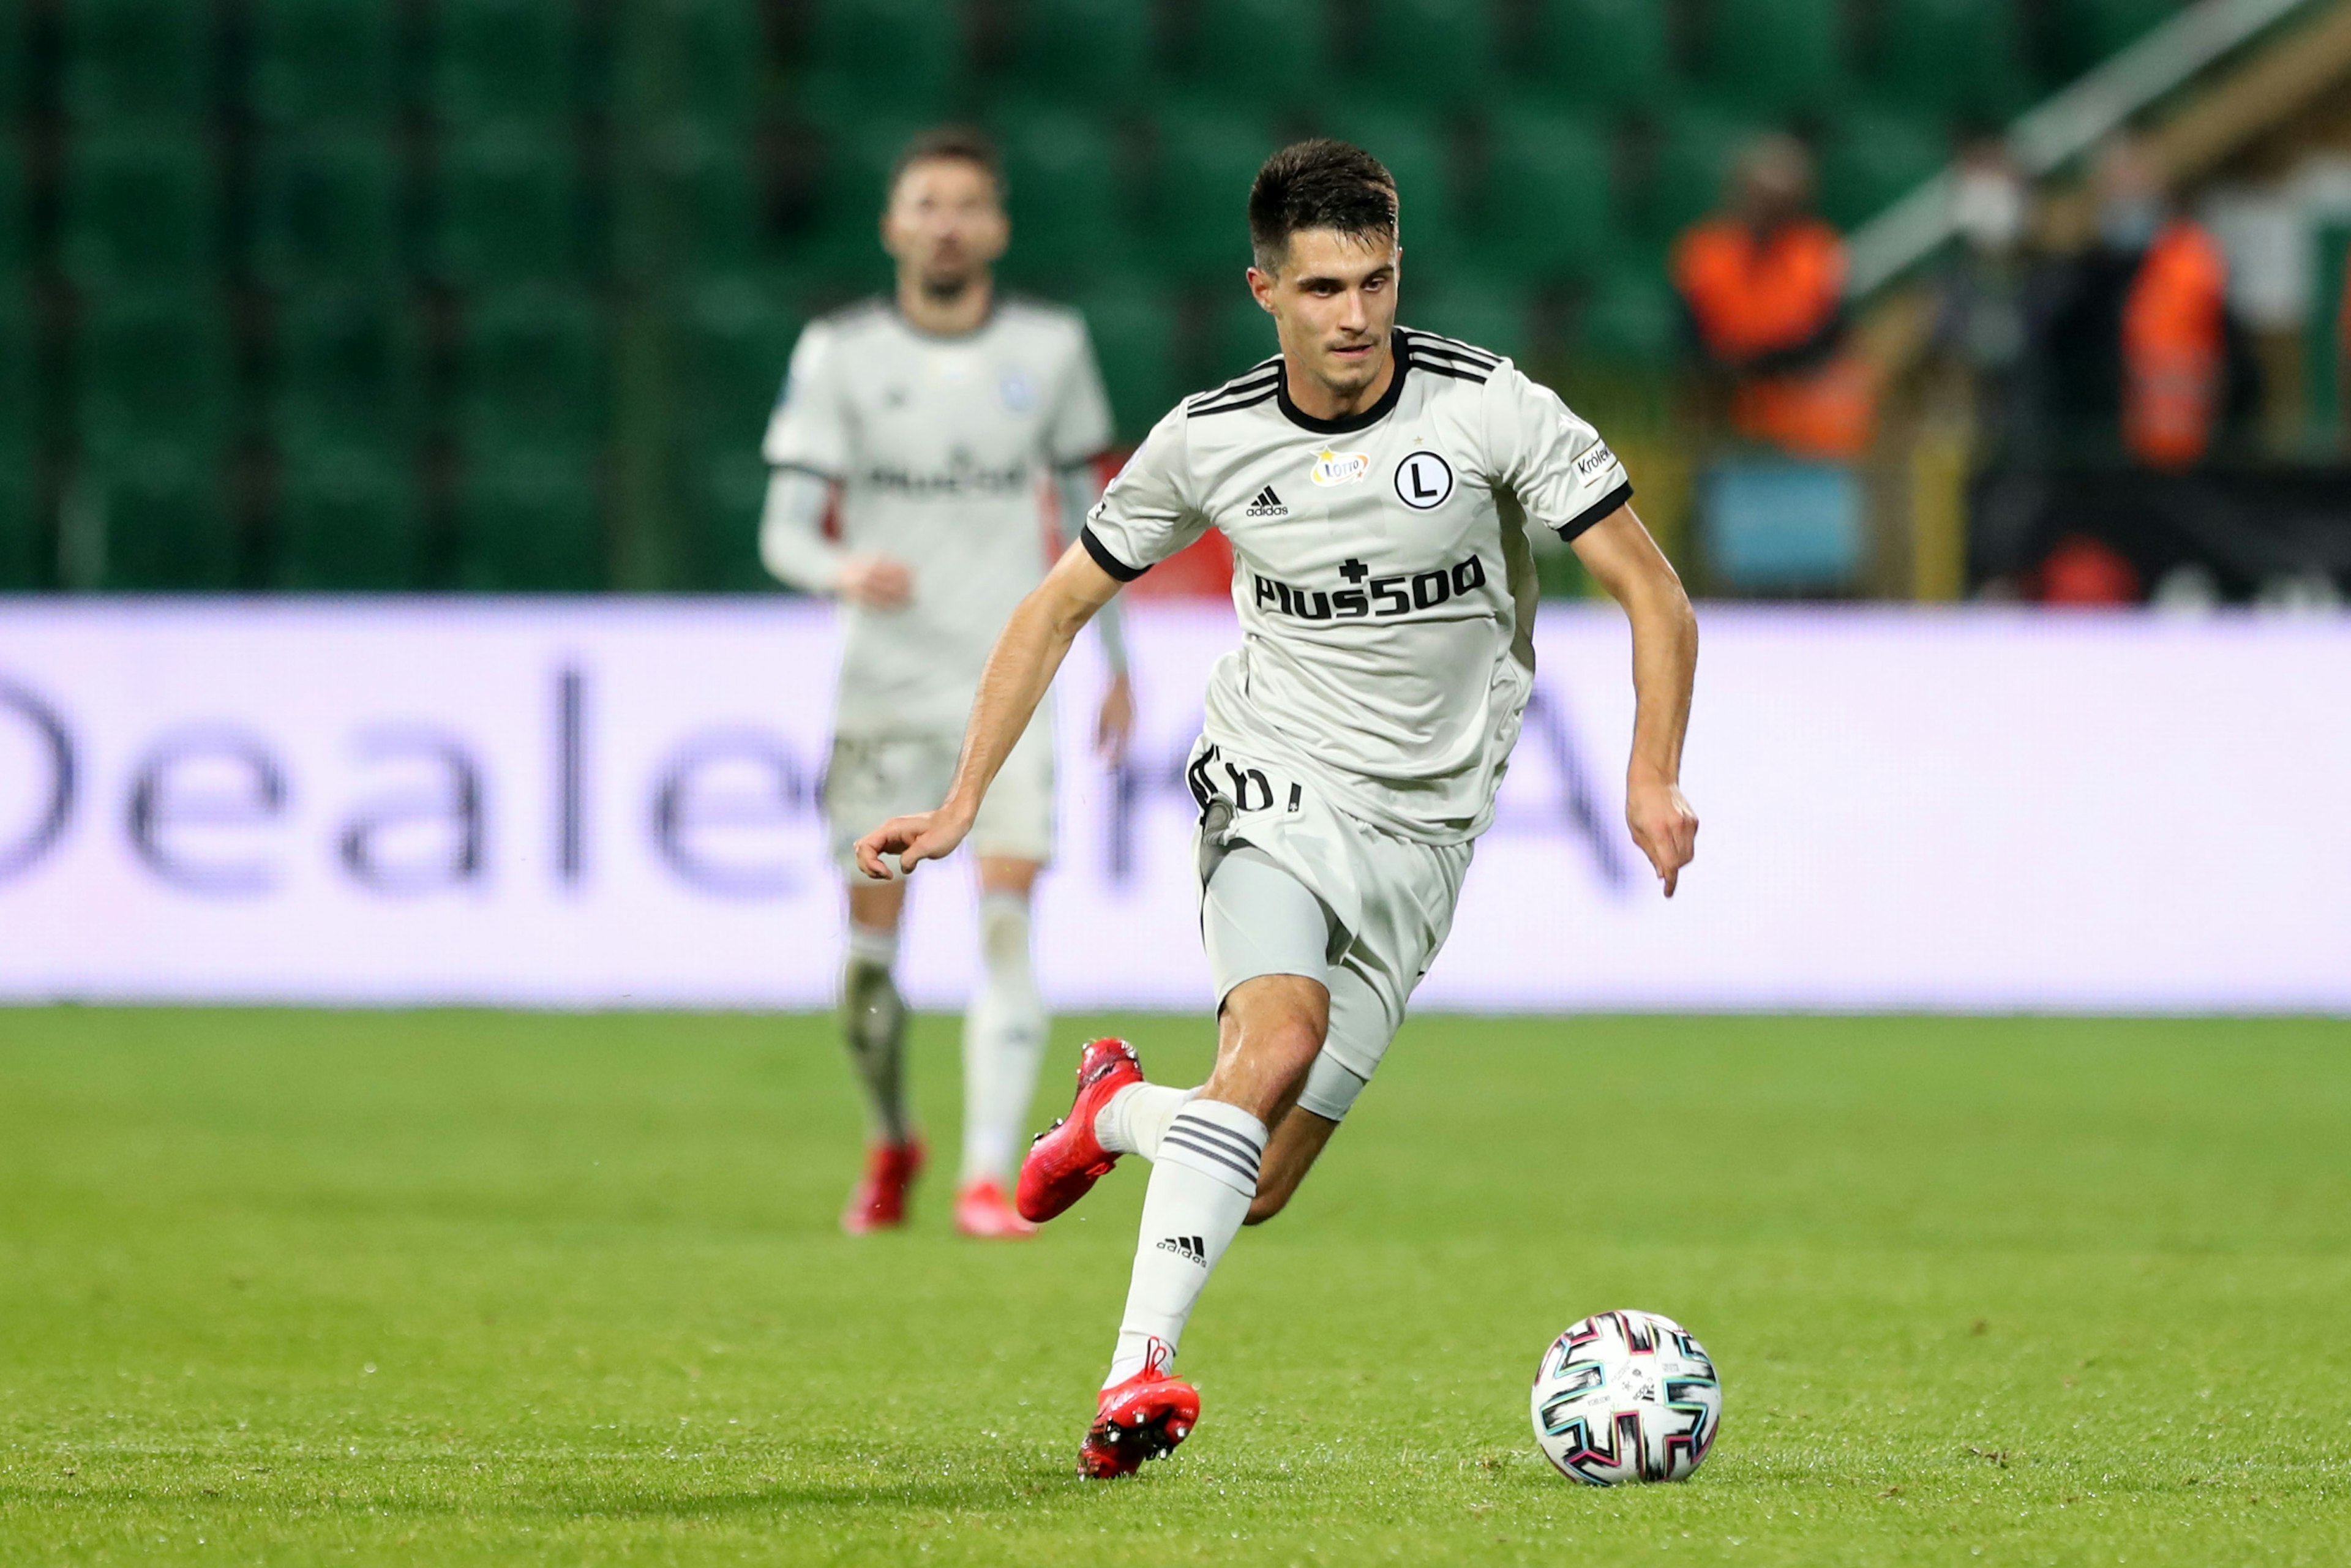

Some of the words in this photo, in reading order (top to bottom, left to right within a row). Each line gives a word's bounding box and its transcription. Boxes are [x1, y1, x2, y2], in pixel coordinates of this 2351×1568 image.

[1411, 463, 1438, 498] L
[1246, 506, 1288, 517] adidas
[1157, 1242, 1207, 1268] adidas
